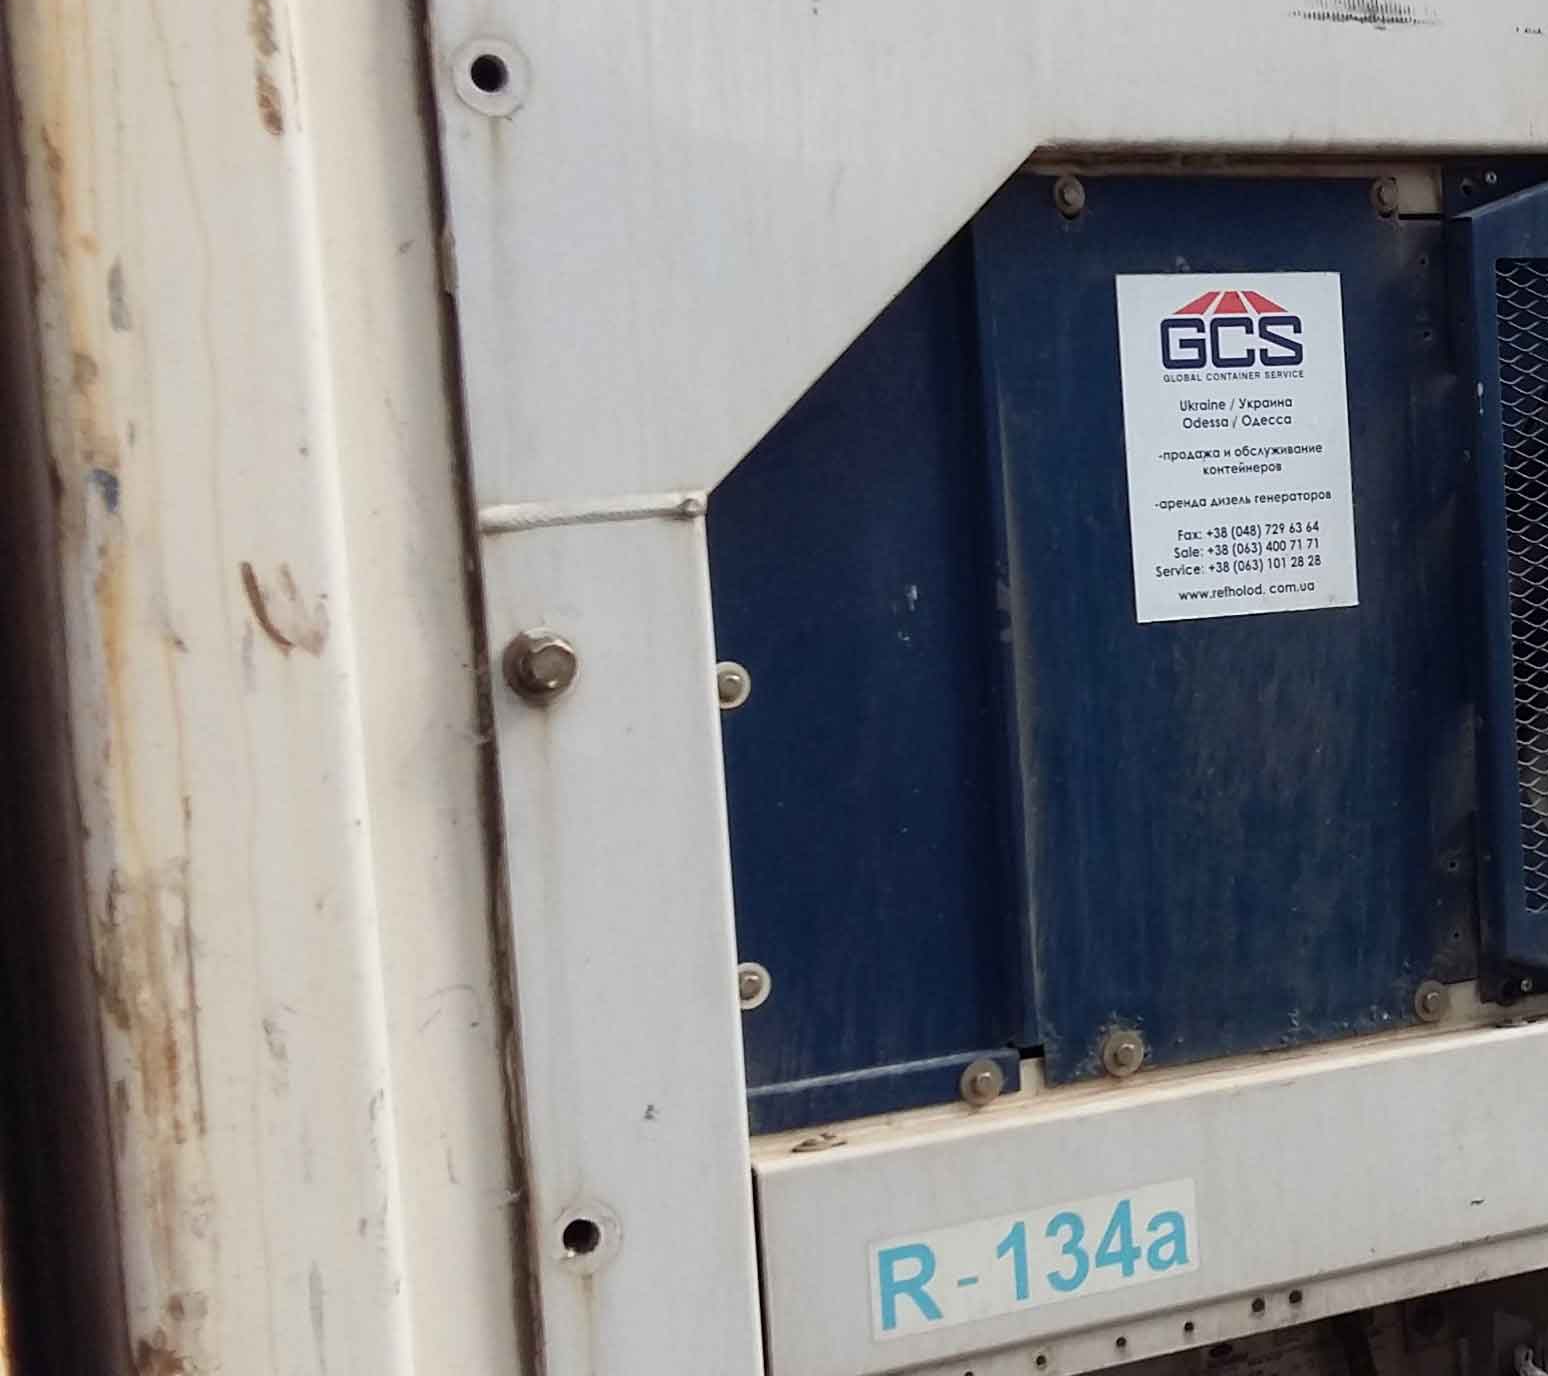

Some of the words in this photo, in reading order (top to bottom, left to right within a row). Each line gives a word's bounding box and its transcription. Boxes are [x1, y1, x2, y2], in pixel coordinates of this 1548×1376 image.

[1160, 315, 1303, 370] GCS
[1163, 371, 1203, 383] GLOBAL
[1206, 370, 1261, 382] CONTAINER
[1264, 369, 1304, 380] SERVICE
[1179, 398, 1226, 412] Ukraine
[1238, 396, 1293, 411] Украина
[1182, 416, 1229, 429] Odessa
[1241, 413, 1292, 428] Одесса
[1158, 448, 1221, 463] -продажа
[1224, 448, 1231, 458] и
[1234, 442, 1323, 459] обслуживание
[1203, 460, 1282, 476] контейнеров
[1155, 496, 1207, 512] -аренда
[1210, 494, 1251, 508] дизель
[1254, 490, 1332, 506] генераторов
[1178, 529, 1203, 542] Fax:
[1206, 527, 1228, 540] +38
[1231, 523, 1262, 540] (048)
[1264, 523, 1286, 536] 729
[1288, 522, 1303, 535] 63
[1306, 521, 1320, 534] 64
[1174, 545, 1204, 559] Sale:
[1207, 544, 1229, 557] +38
[1232, 541, 1263, 557] (063)
[1265, 539, 1287, 552] 400
[1289, 538, 1303, 551] 71
[1306, 537, 1320, 550] 71
[1155, 564, 1205, 578] Service:
[1208, 561, 1230, 574] +38
[1233, 558, 1264, 574] (063)
[1267, 556, 1288, 570] 101
[1290, 555, 1305, 568] 28
[1307, 555, 1321, 567] 28
[877, 1199, 1190, 1331] R-134a
